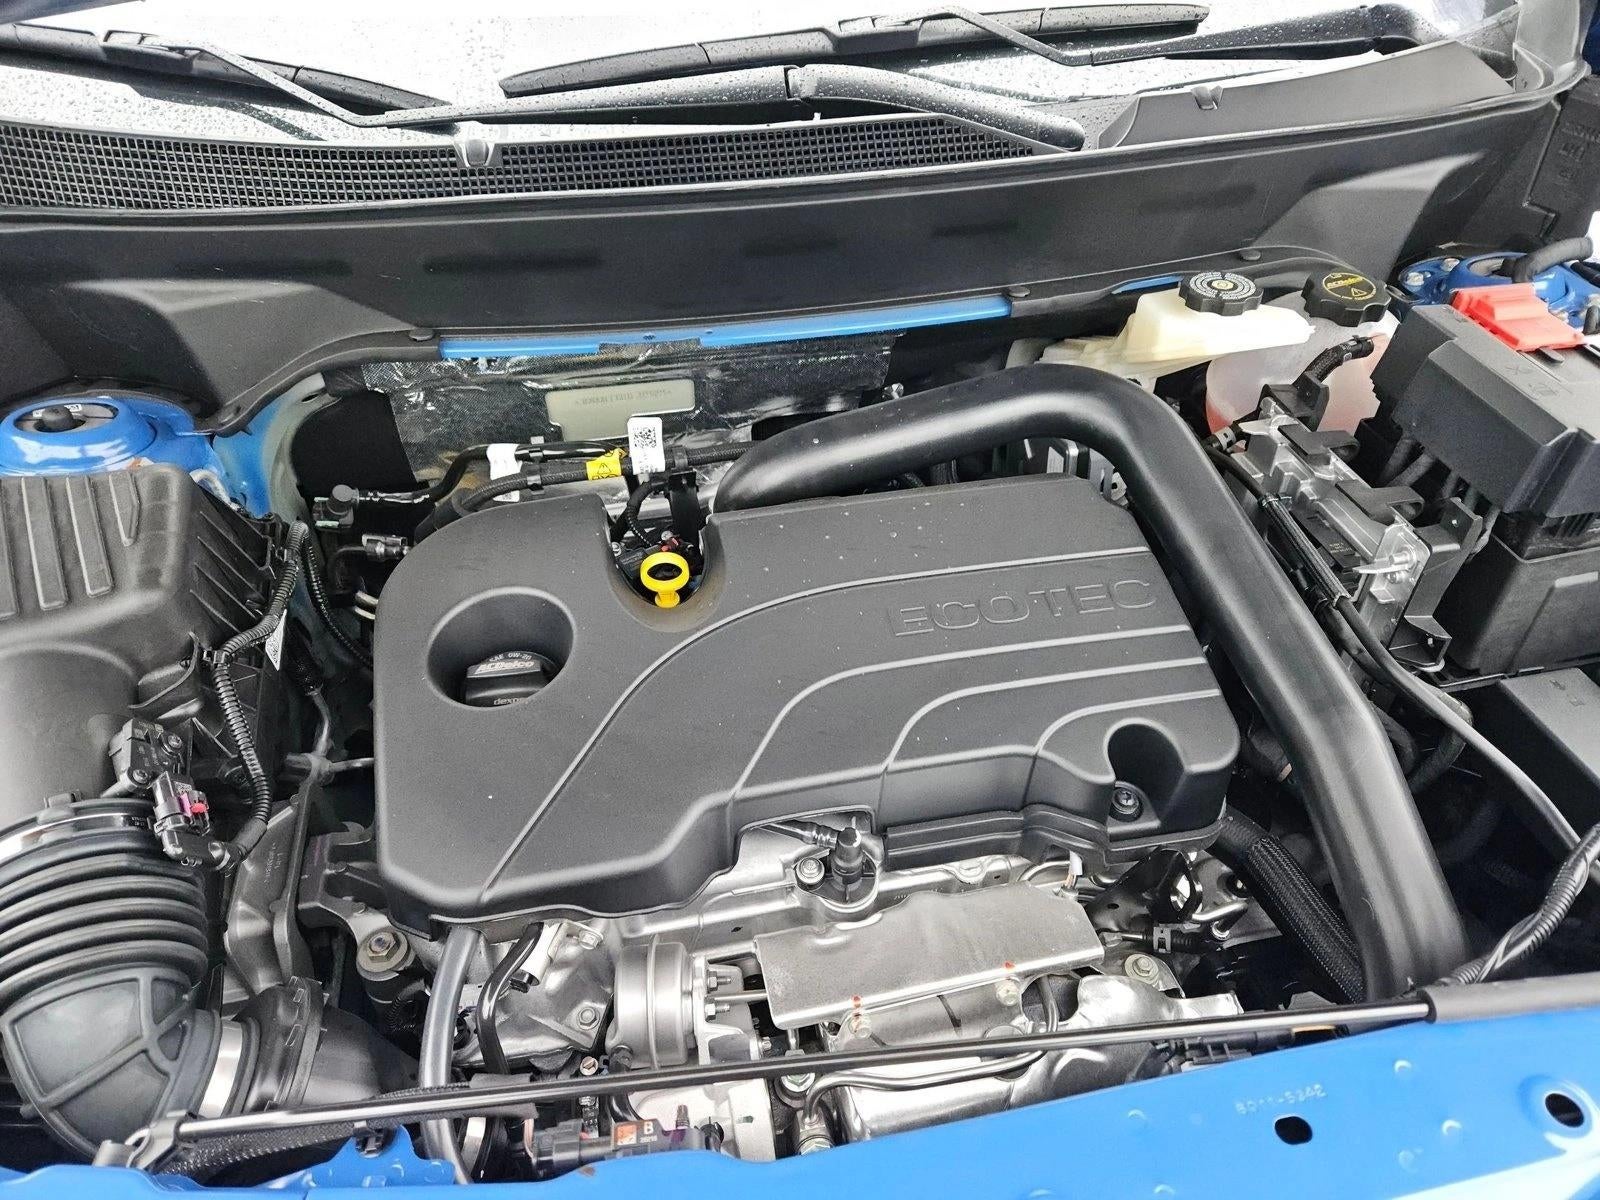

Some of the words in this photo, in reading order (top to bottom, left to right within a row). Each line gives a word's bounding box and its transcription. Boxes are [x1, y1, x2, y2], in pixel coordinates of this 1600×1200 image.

[887, 579, 1157, 637] ECOTEC
[474, 660, 535, 674] ACDelco
[643, 1121, 654, 1135] B
